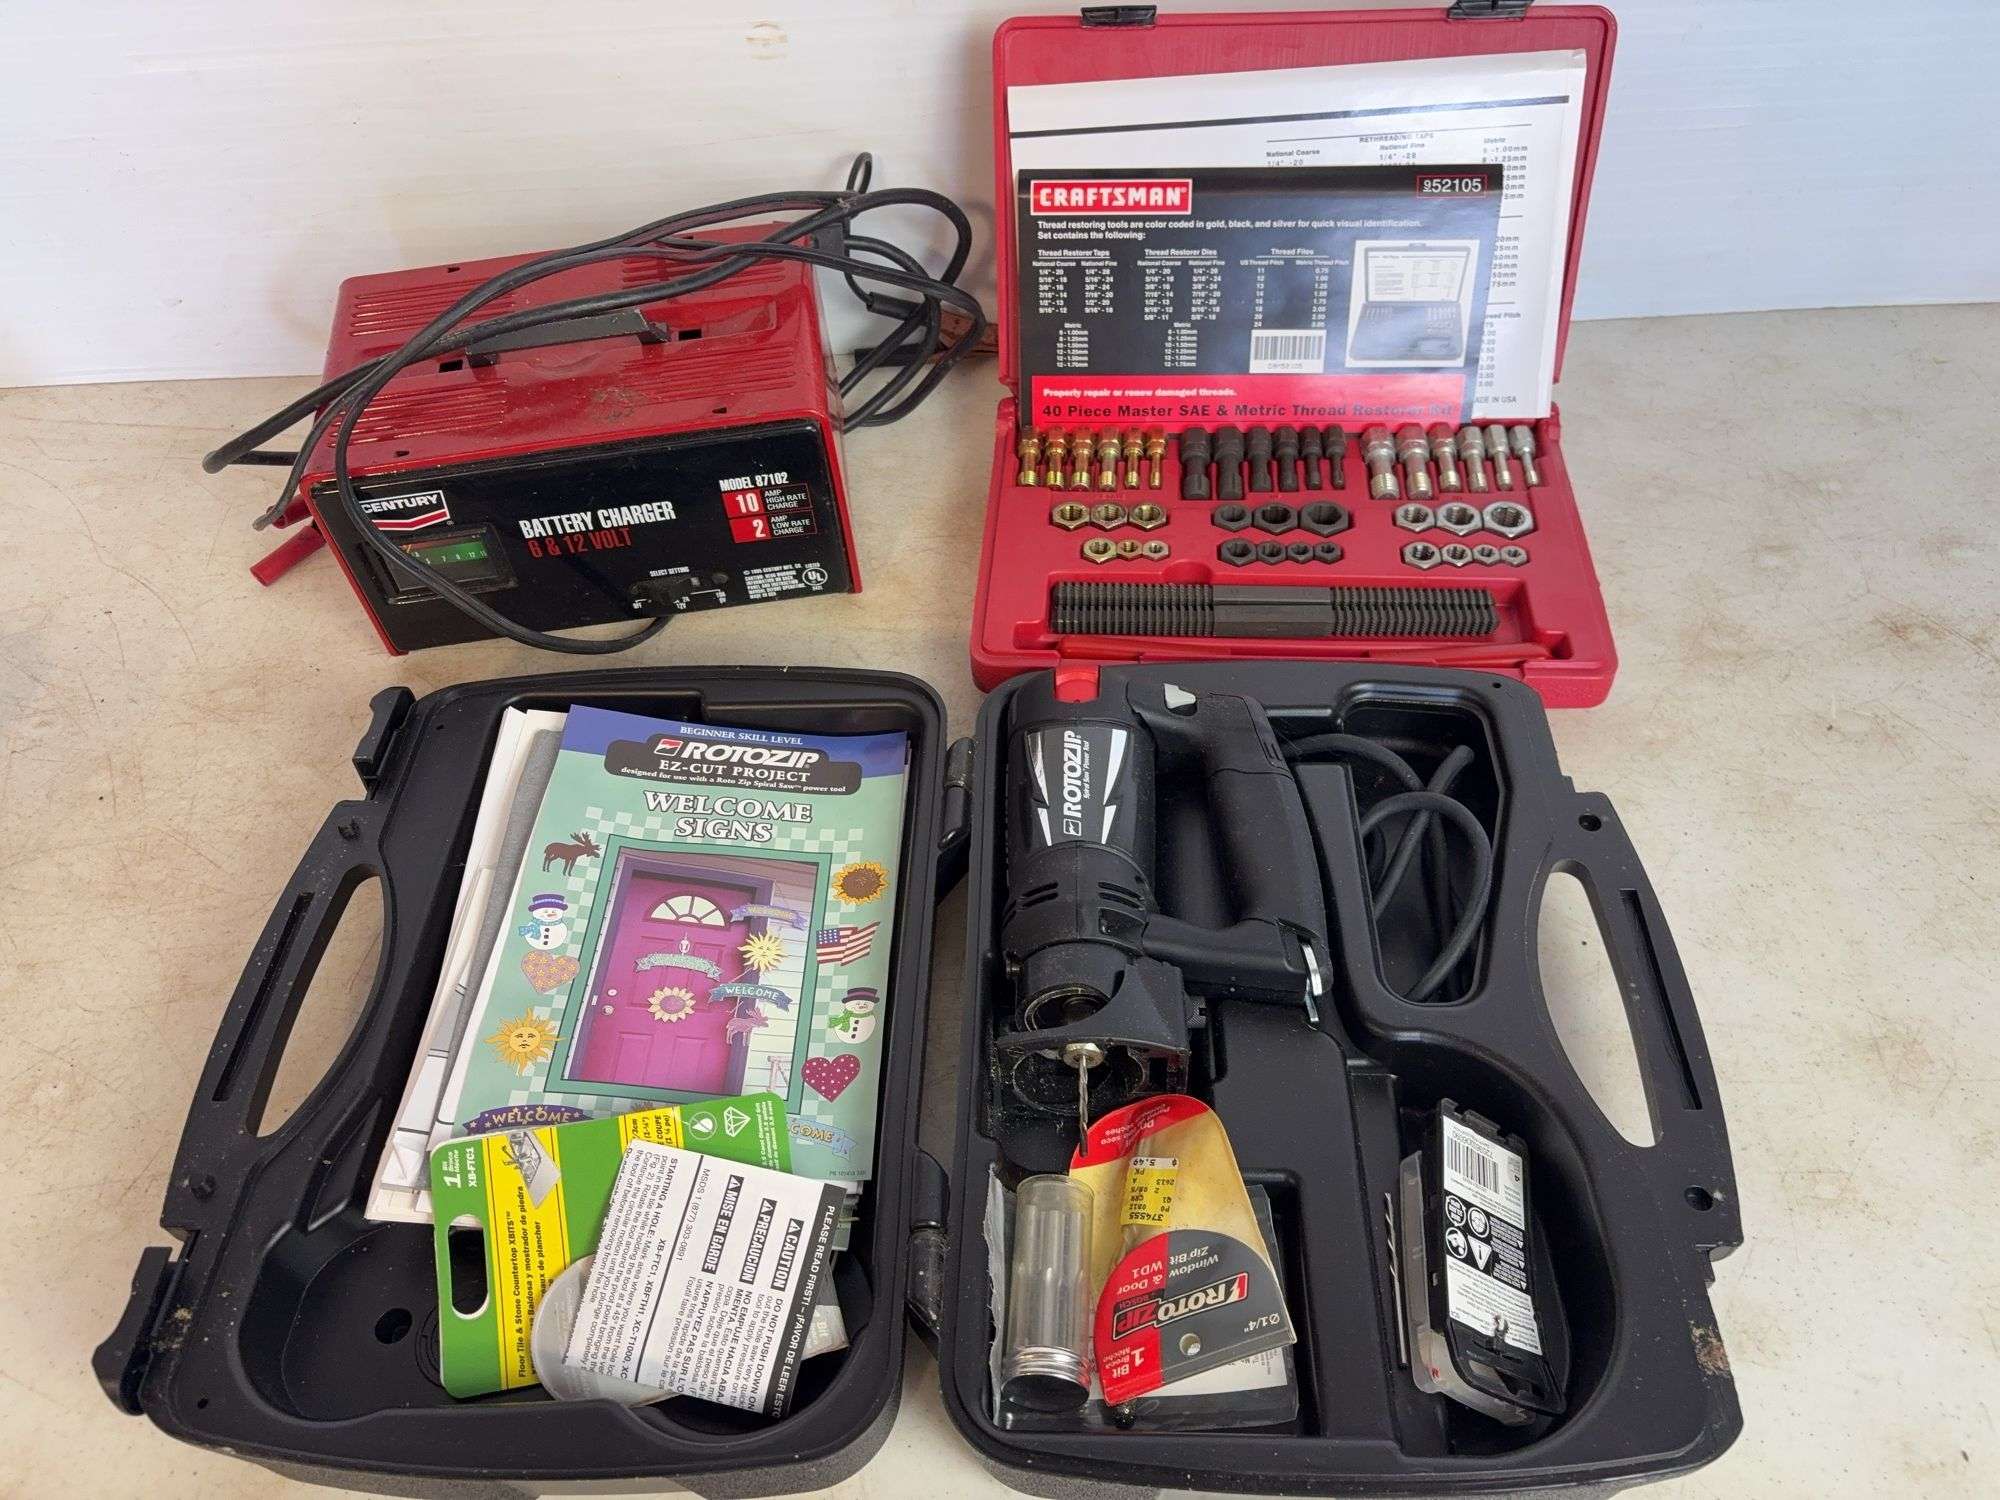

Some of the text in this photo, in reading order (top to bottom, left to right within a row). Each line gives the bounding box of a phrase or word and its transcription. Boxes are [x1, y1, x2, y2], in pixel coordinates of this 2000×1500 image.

[1039, 186, 1187, 207] CRAFTSMAN
[1038, 220, 1066, 229] Thread
[1068, 221, 1106, 230] restoring
[1107, 221, 1128, 229] tools
[1144, 220, 1166, 228] color
[1168, 220, 1194, 228] coded
[1196, 220, 1204, 228] in
[1206, 220, 1227, 230] gold,
[1228, 220, 1252, 229] black,
[1255, 220, 1270, 228] and
[1272, 220, 1296, 228] silver
[1298, 220, 1310, 228] for
[1311, 220, 1334, 229] quick
[1336, 220, 1362, 228] visual
[1038, 232, 1146, 240] Set contains the following:
[1038, 249, 1110, 258] Thread Restorer Taps
[1144, 248, 1169, 256] Thread
[1170, 248, 1200, 256] Restorer
[1270, 248, 1296, 256] Thread
[1042, 388, 1082, 398] Properly
[1084, 389, 1111, 398] repair
[1155, 388, 1197, 398] damaged
[1042, 405, 1062, 416] 40
[1068, 405, 1112, 416] Piece
[1118, 405, 1173, 416] Master
[1179, 404, 1210, 416] SAE
[1216, 404, 1228, 416] &
[1234, 404, 1286, 416] Metric
[1292, 404, 1346, 416] Thread
[719, 472, 790, 492] MODEL 87102
[361, 494, 438, 514] CENTURY
[736, 492, 760, 514] 10
[764, 489, 782, 498] AMP
[766, 492, 807, 504] HIGH RATE
[767, 501, 798, 511] CHARGE
[518, 500, 677, 539] BATTERY CHARGER
[752, 519, 766, 538] 2
[770, 515, 788, 523] AMP
[772, 518, 811, 530] LOW RATE
[774, 526, 804, 536] CHARGE
[528, 528, 632, 558] 6 & 12 VOLT
[680, 726, 803, 746] BEGINNER SKILL LEVEL
[680, 742, 820, 768] ROTOZIP
[621, 766, 658, 779] designed
[658, 770, 672, 780] for
[690, 774, 708, 782] with
[716, 776, 736, 785] Roto
[738, 778, 752, 788] Zip
[754, 780, 777, 790] Spiral
[803, 784, 829, 794] power
[830, 785, 846, 793] tool
[658, 760, 811, 782] EZ-CUT PROJECT
[1062, 730, 1082, 817] ROTOZIP
[644, 790, 813, 824] WELCOME
[674, 817, 773, 842] SIGNS
[724, 985, 780, 1000] WELCOME
[492, 1111, 572, 1125] WELCOME
[465, 1146, 476, 1187] XB-FTC1
[1133, 1158, 1155, 1166] 5.49
[442, 1173, 461, 1188] 1
[658, 1156, 677, 1201] STARTING
[696, 1167, 710, 1194] MSDS
[516, 1186, 525, 1212] piedra
[519, 1215, 526, 1224] de
[686, 1201, 699, 1223] (877)
[1128, 1211, 1163, 1222] 374555
[646, 1210, 660, 1239] HOLE:
[703, 1188, 738, 1271] MISE EN GARDE
[520, 1228, 530, 1271] mostrador
[534, 1221, 544, 1270] de plancher
[639, 1239, 651, 1260] Mark
[675, 1223, 693, 1261] 303-0891
[741, 1213, 770, 1282] PRECAUCION
[510, 1247, 520, 1295] Countertop
[632, 1260, 643, 1279] area
[772, 1233, 798, 1288] CAUTION
[1130, 1259, 1163, 1279] WD1
[1114, 1253, 1220, 1296] Window & Door
[525, 1280, 534, 1314] Baldosa
[625, 1280, 638, 1306] where
[776, 1205, 835, 1392] PLEASE READ FIRST! ¡FAVOR DE LEER
[619, 1306, 629, 1322] you
[614, 1323, 625, 1344] want
[679, 1279, 713, 1375] N'APPUYEZ PAS SUR
[721, 1290, 752, 1376] NO EMPUJE HACIA
[609, 1344, 620, 1363] hole
[746, 1297, 783, 1410] DO NOT PUSH DOWN ON
[1128, 1346, 1148, 1367] 1
[517, 1355, 526, 1376] Floor
[1110, 1363, 1131, 1378] Bit
